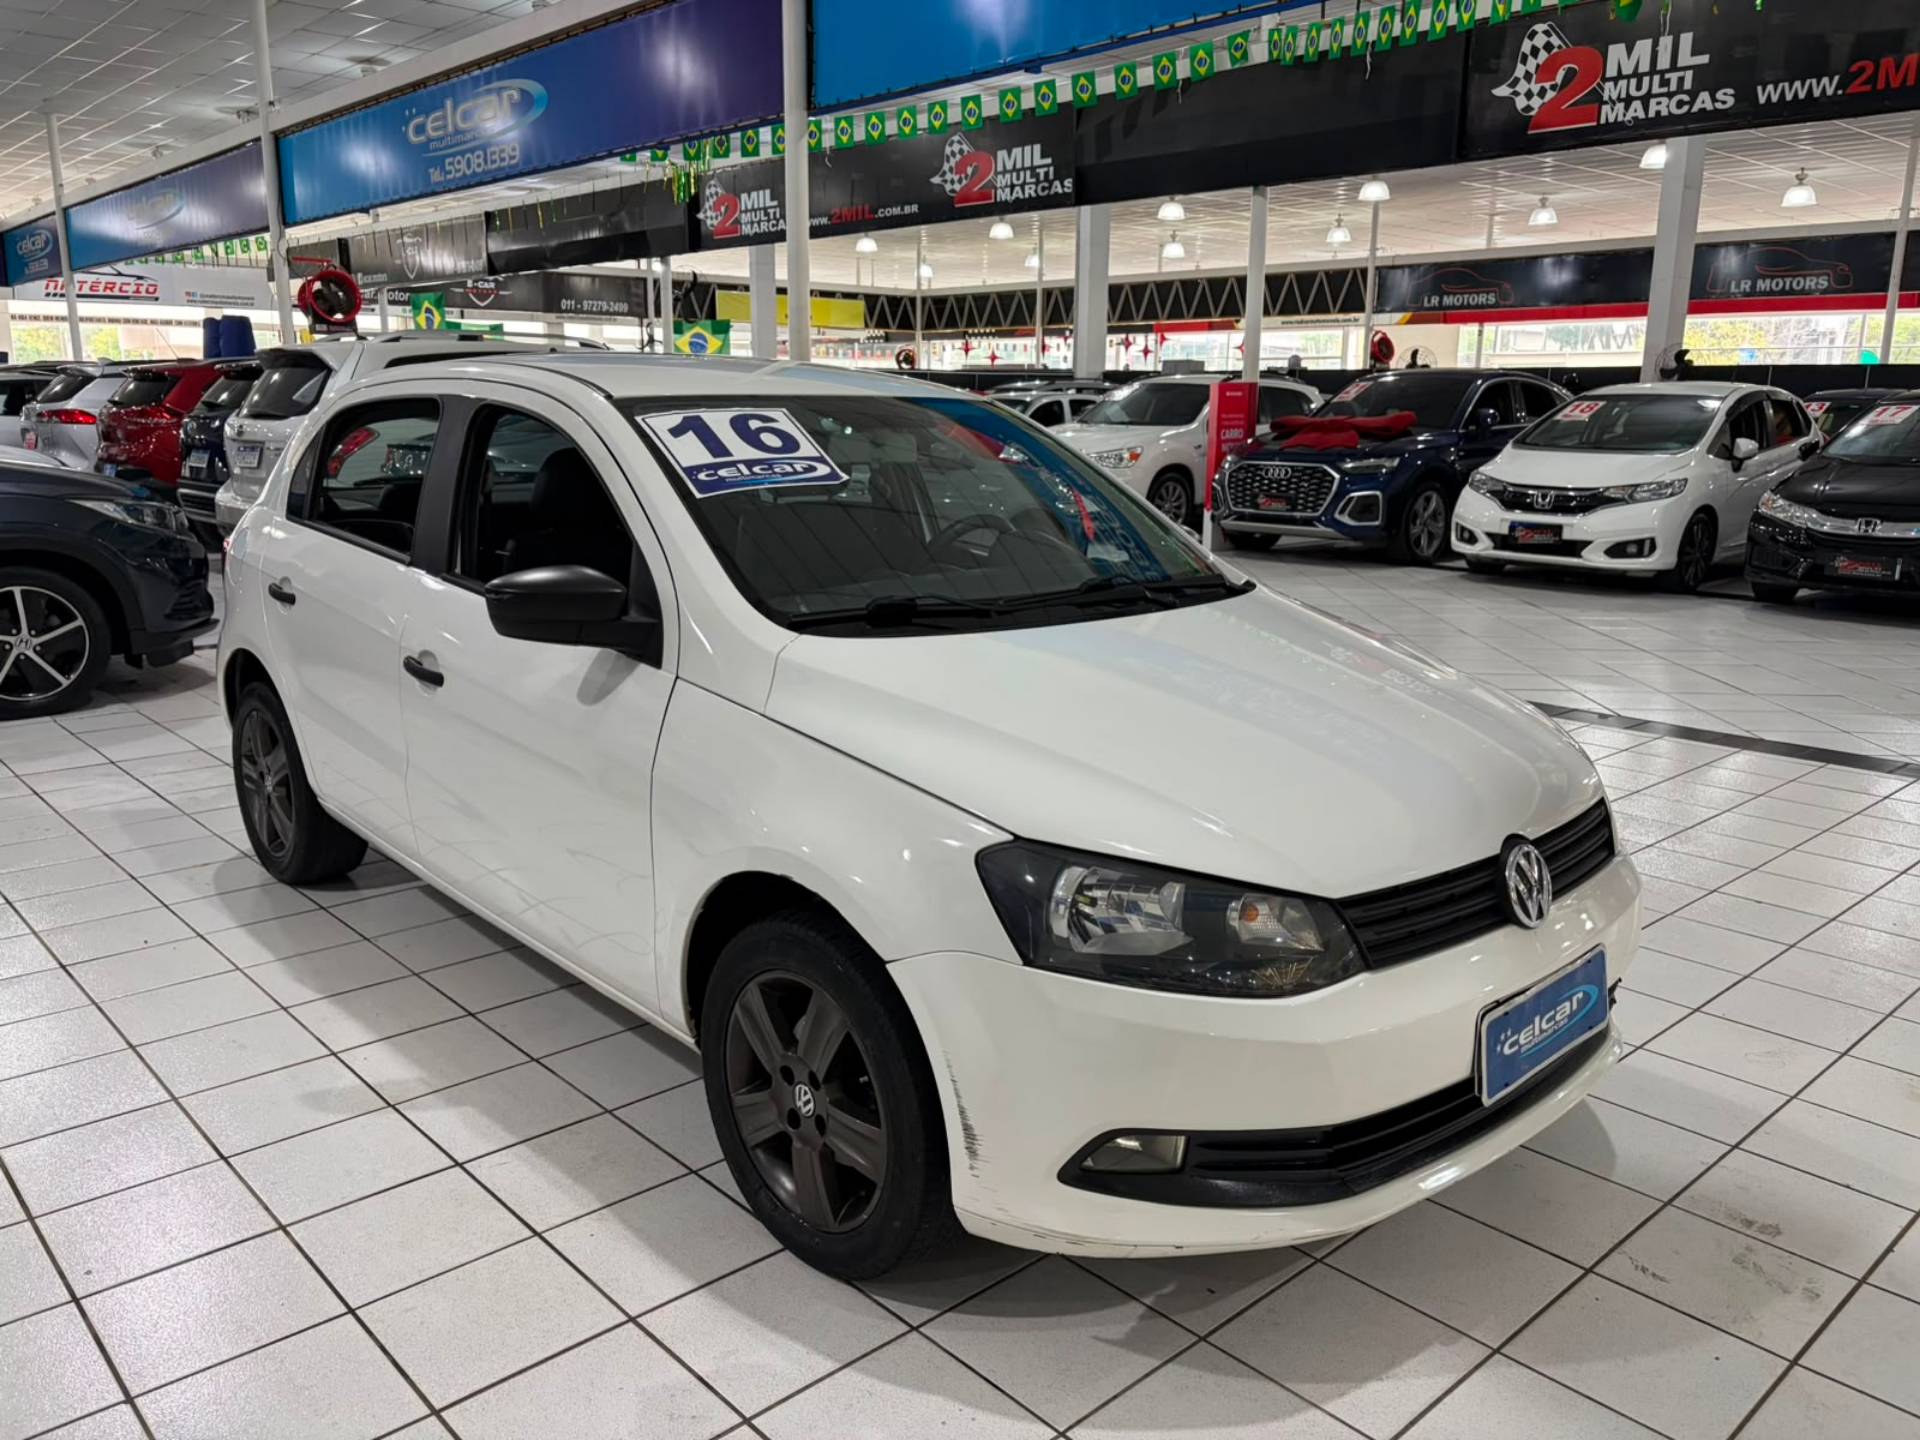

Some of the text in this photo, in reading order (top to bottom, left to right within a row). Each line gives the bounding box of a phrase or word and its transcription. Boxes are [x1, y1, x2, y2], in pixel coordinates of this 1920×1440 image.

[1527, 32, 1710, 134] 2 MIL
[1602, 70, 1694, 99] MULTI
[1756, 52, 1920, 105] WWW.2M
[407, 89, 522, 145] celcar
[1600, 87, 1736, 125] MARCAS
[445, 143, 520, 180] 5908.1339
[954, 143, 1052, 208] 2 MIL
[996, 178, 1073, 203] MARCAS
[997, 166, 1055, 187] MULTI
[740, 188, 778, 210] MIL
[740, 207, 780, 224] MULTI
[741, 219, 786, 236] MARCA
[1729, 275, 1828, 293] LR MOTORS
[1424, 292, 1496, 307] LR MOTORS
[667, 413, 800, 459] 16
[697, 463, 809, 480] celcar
[1503, 991, 1583, 1055] celcar
